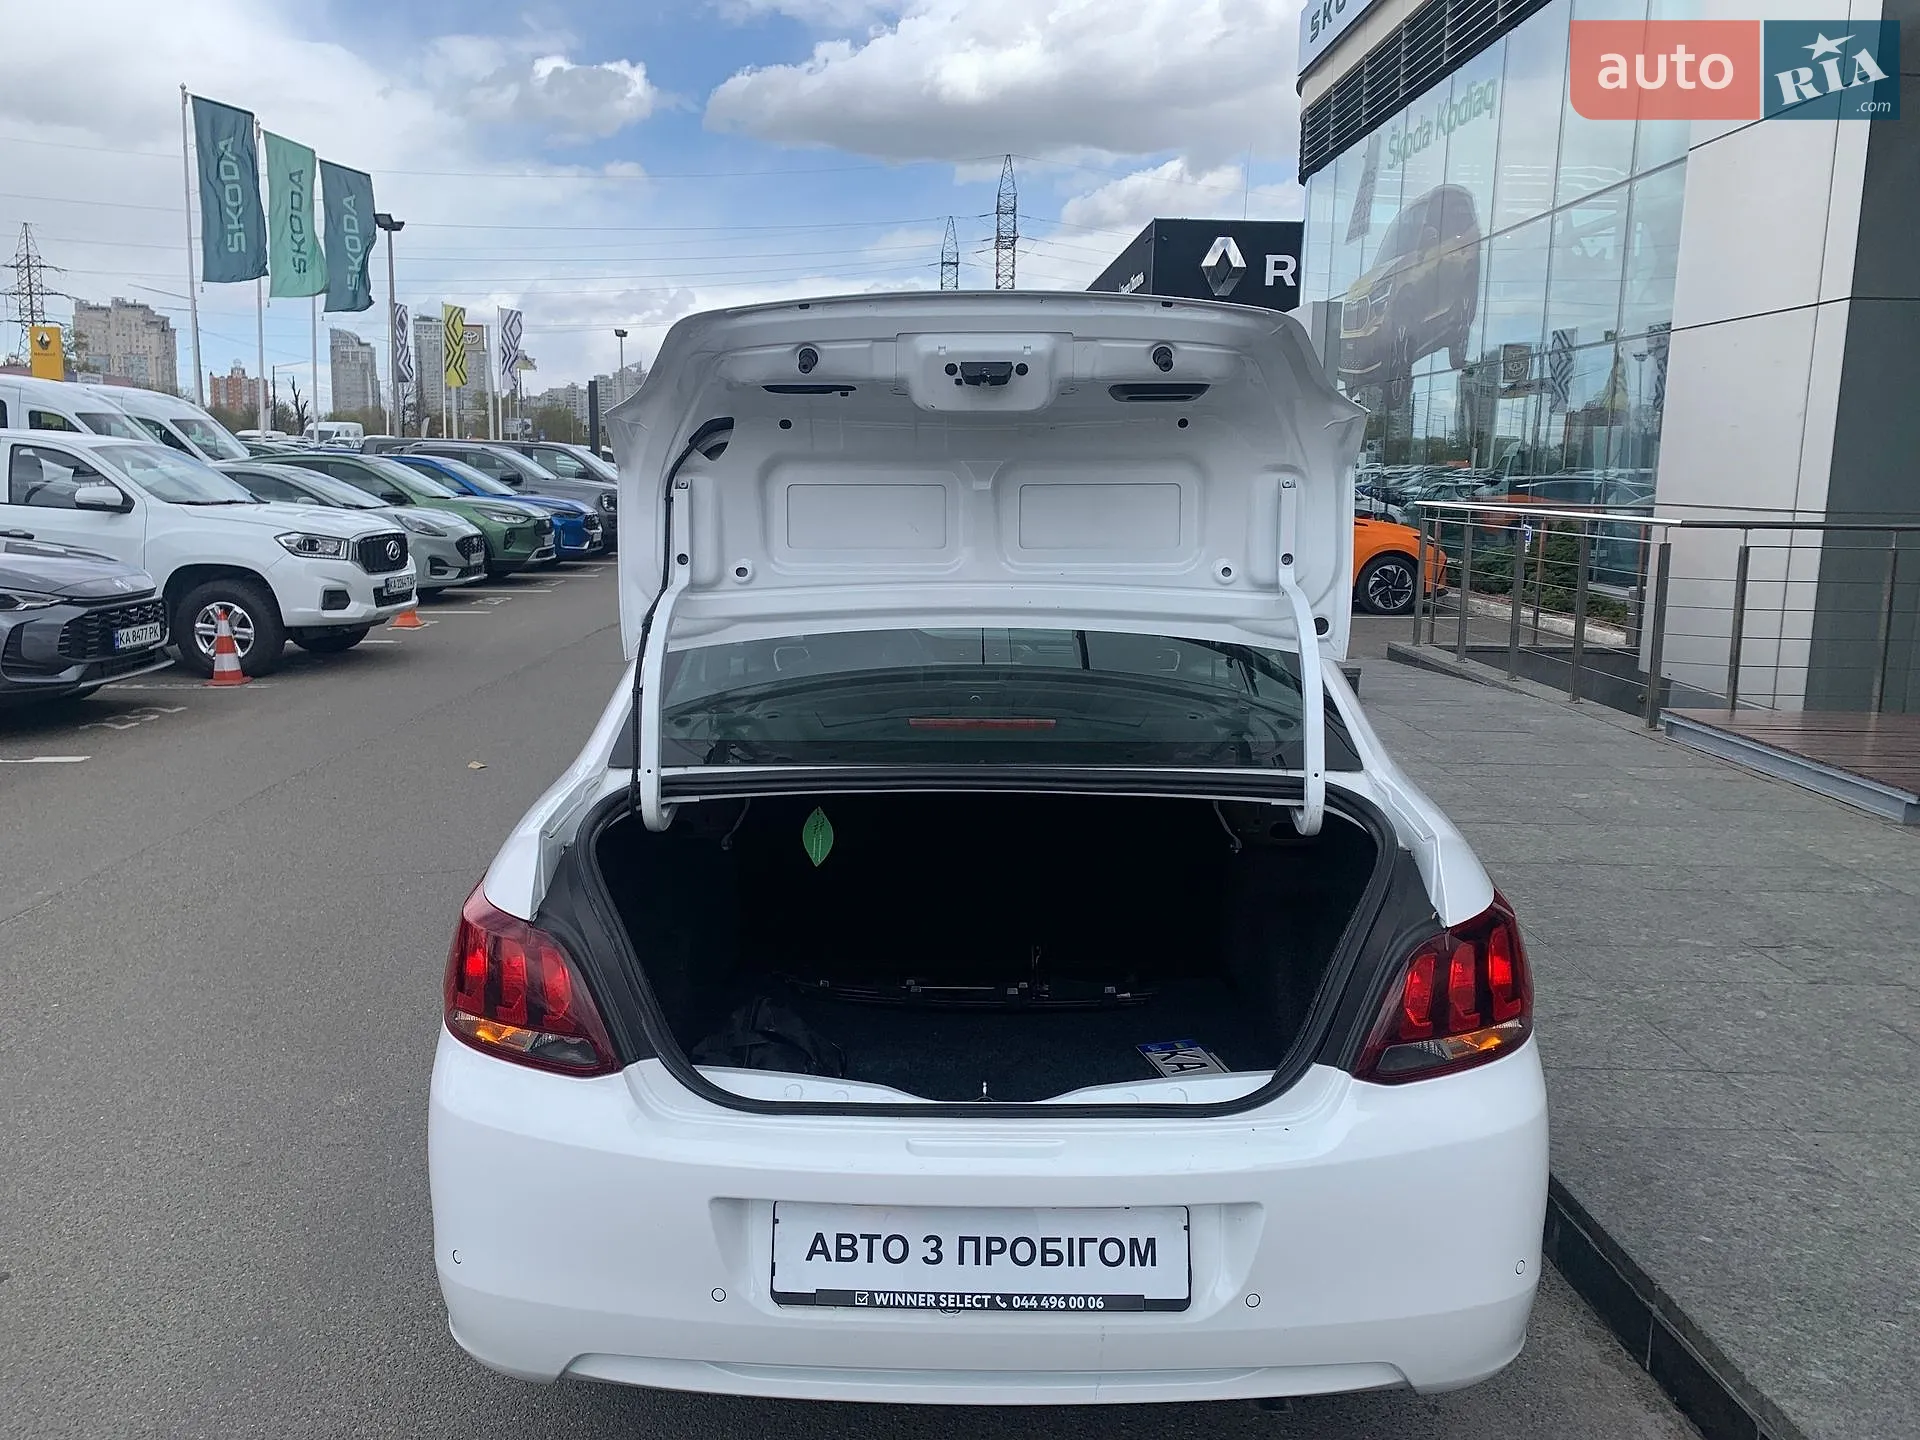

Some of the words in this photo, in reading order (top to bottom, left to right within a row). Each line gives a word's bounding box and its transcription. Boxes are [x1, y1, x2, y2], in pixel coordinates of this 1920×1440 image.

[120, 631, 131, 646] KA
[132, 627, 148, 642] 8477
[149, 624, 159, 639] PK
[805, 1232, 910, 1265] АВТО
[958, 1236, 1158, 1267] ПРОБІГОМ
[874, 1292, 936, 1307] WINNER
[939, 1294, 991, 1308] SELECT
[1013, 1296, 1037, 1309] 044
[1041, 1296, 1066, 1309] 496
[1068, 1297, 1085, 1309] 00
[1087, 1297, 1105, 1310] 06
